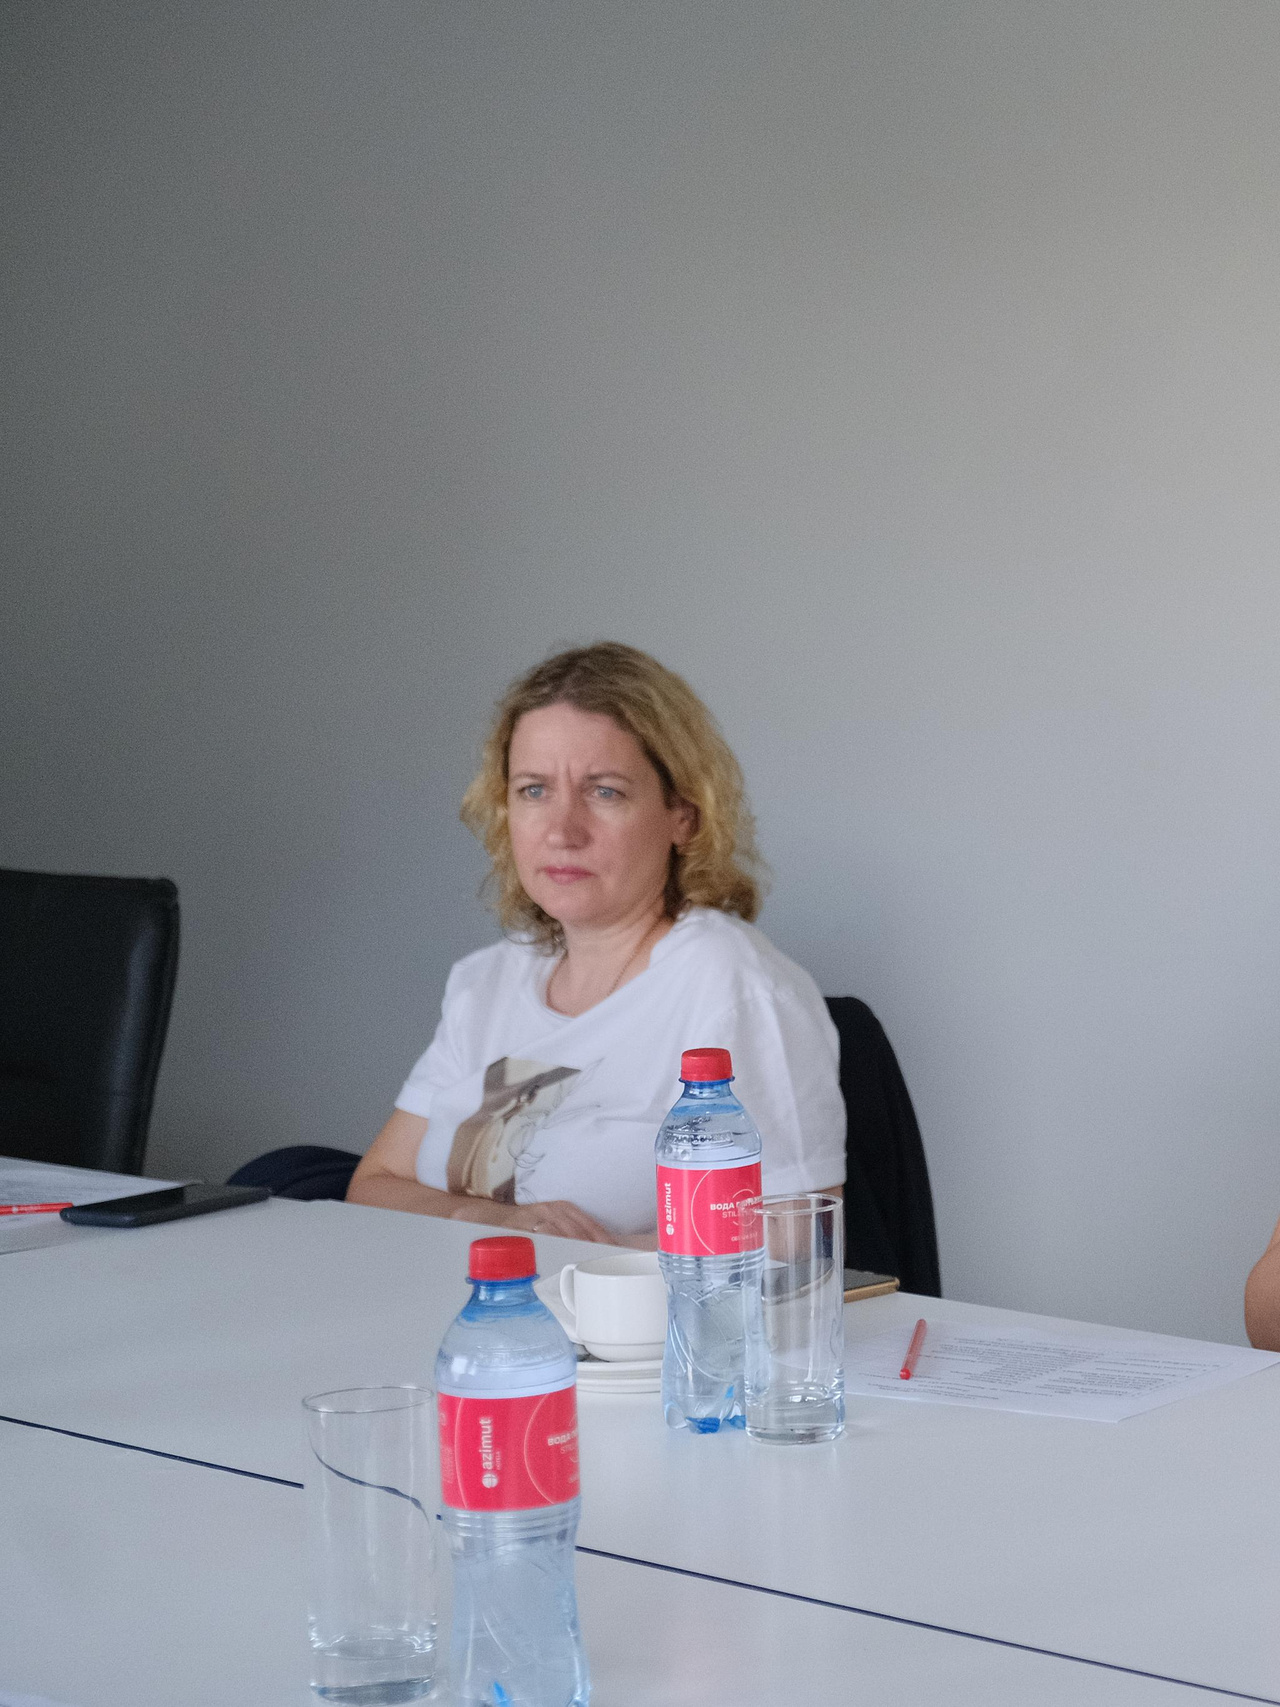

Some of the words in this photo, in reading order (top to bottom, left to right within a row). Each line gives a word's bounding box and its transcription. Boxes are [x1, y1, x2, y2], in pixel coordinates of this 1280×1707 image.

[664, 1182, 672, 1222] azimut
[710, 1202, 734, 1211] ВОДА
[479, 1416, 492, 1470] azimut
